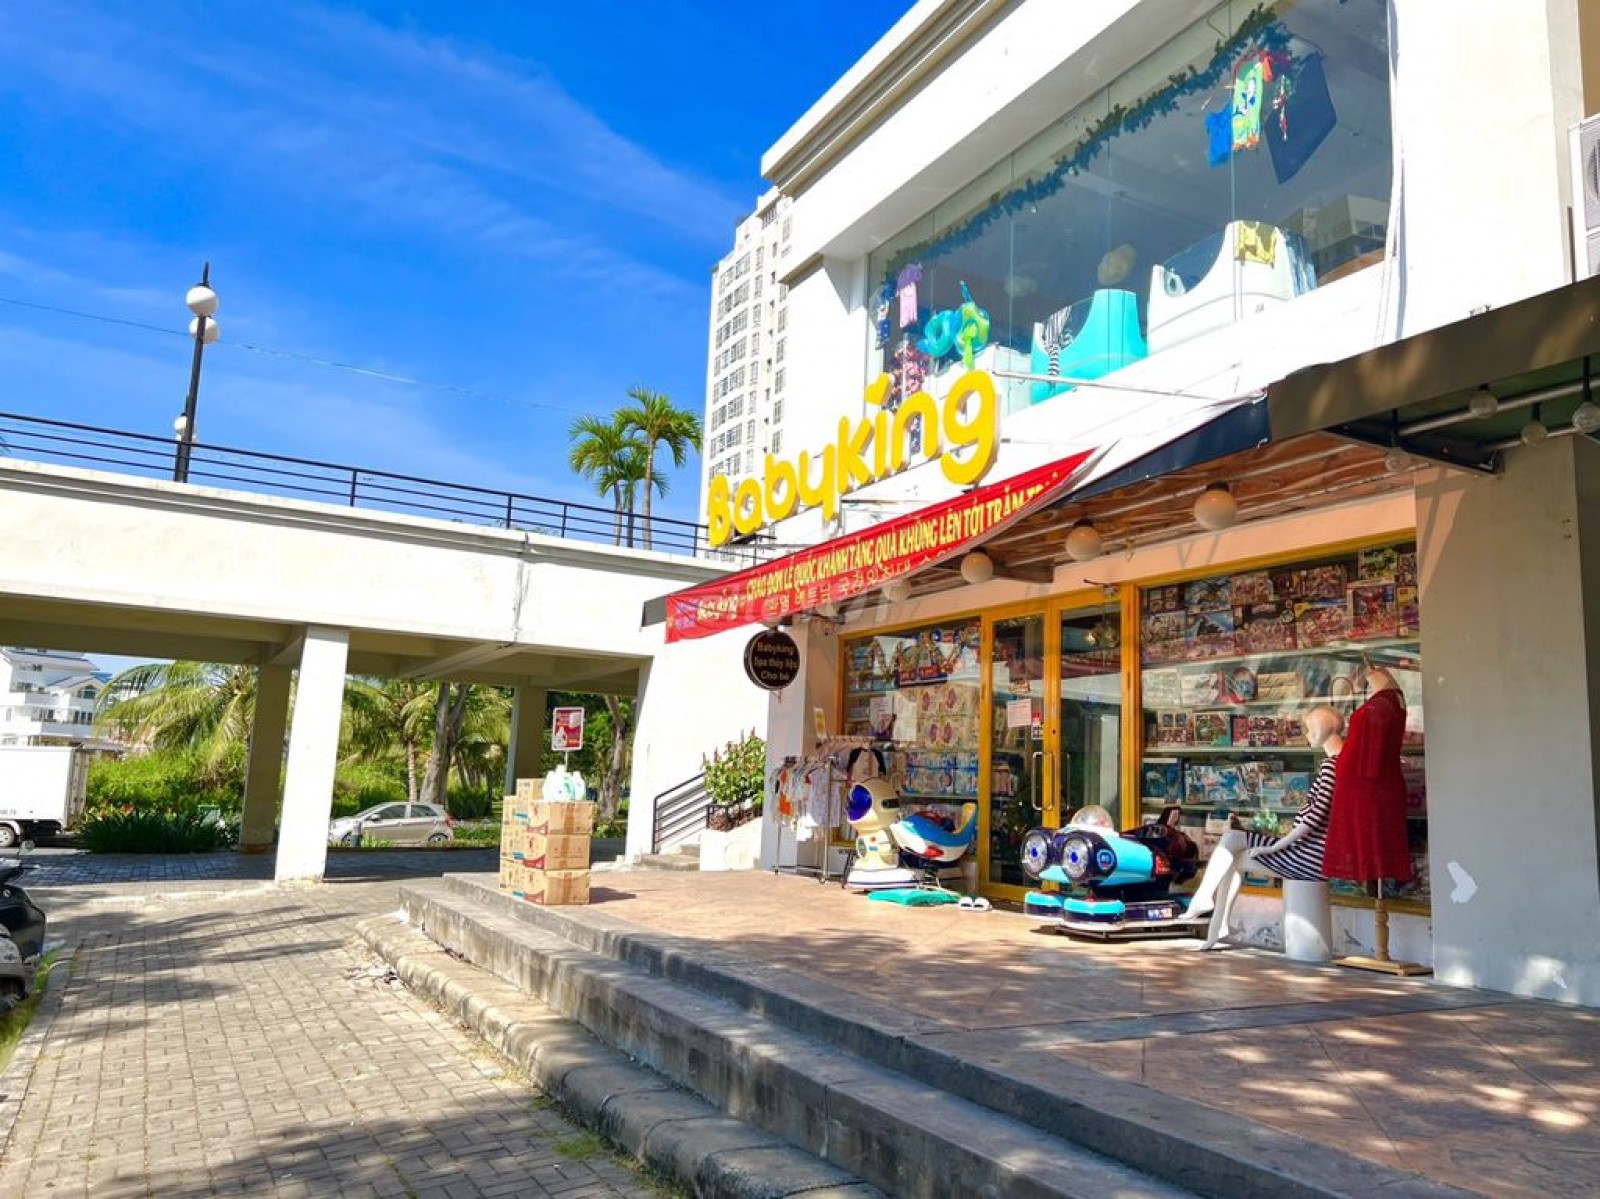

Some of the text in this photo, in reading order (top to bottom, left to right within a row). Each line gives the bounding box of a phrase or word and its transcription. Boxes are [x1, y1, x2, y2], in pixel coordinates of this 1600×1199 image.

[708, 369, 998, 547] Babyking
[757, 642, 795, 656] Babyking
[760, 671, 778, 680] Cho
